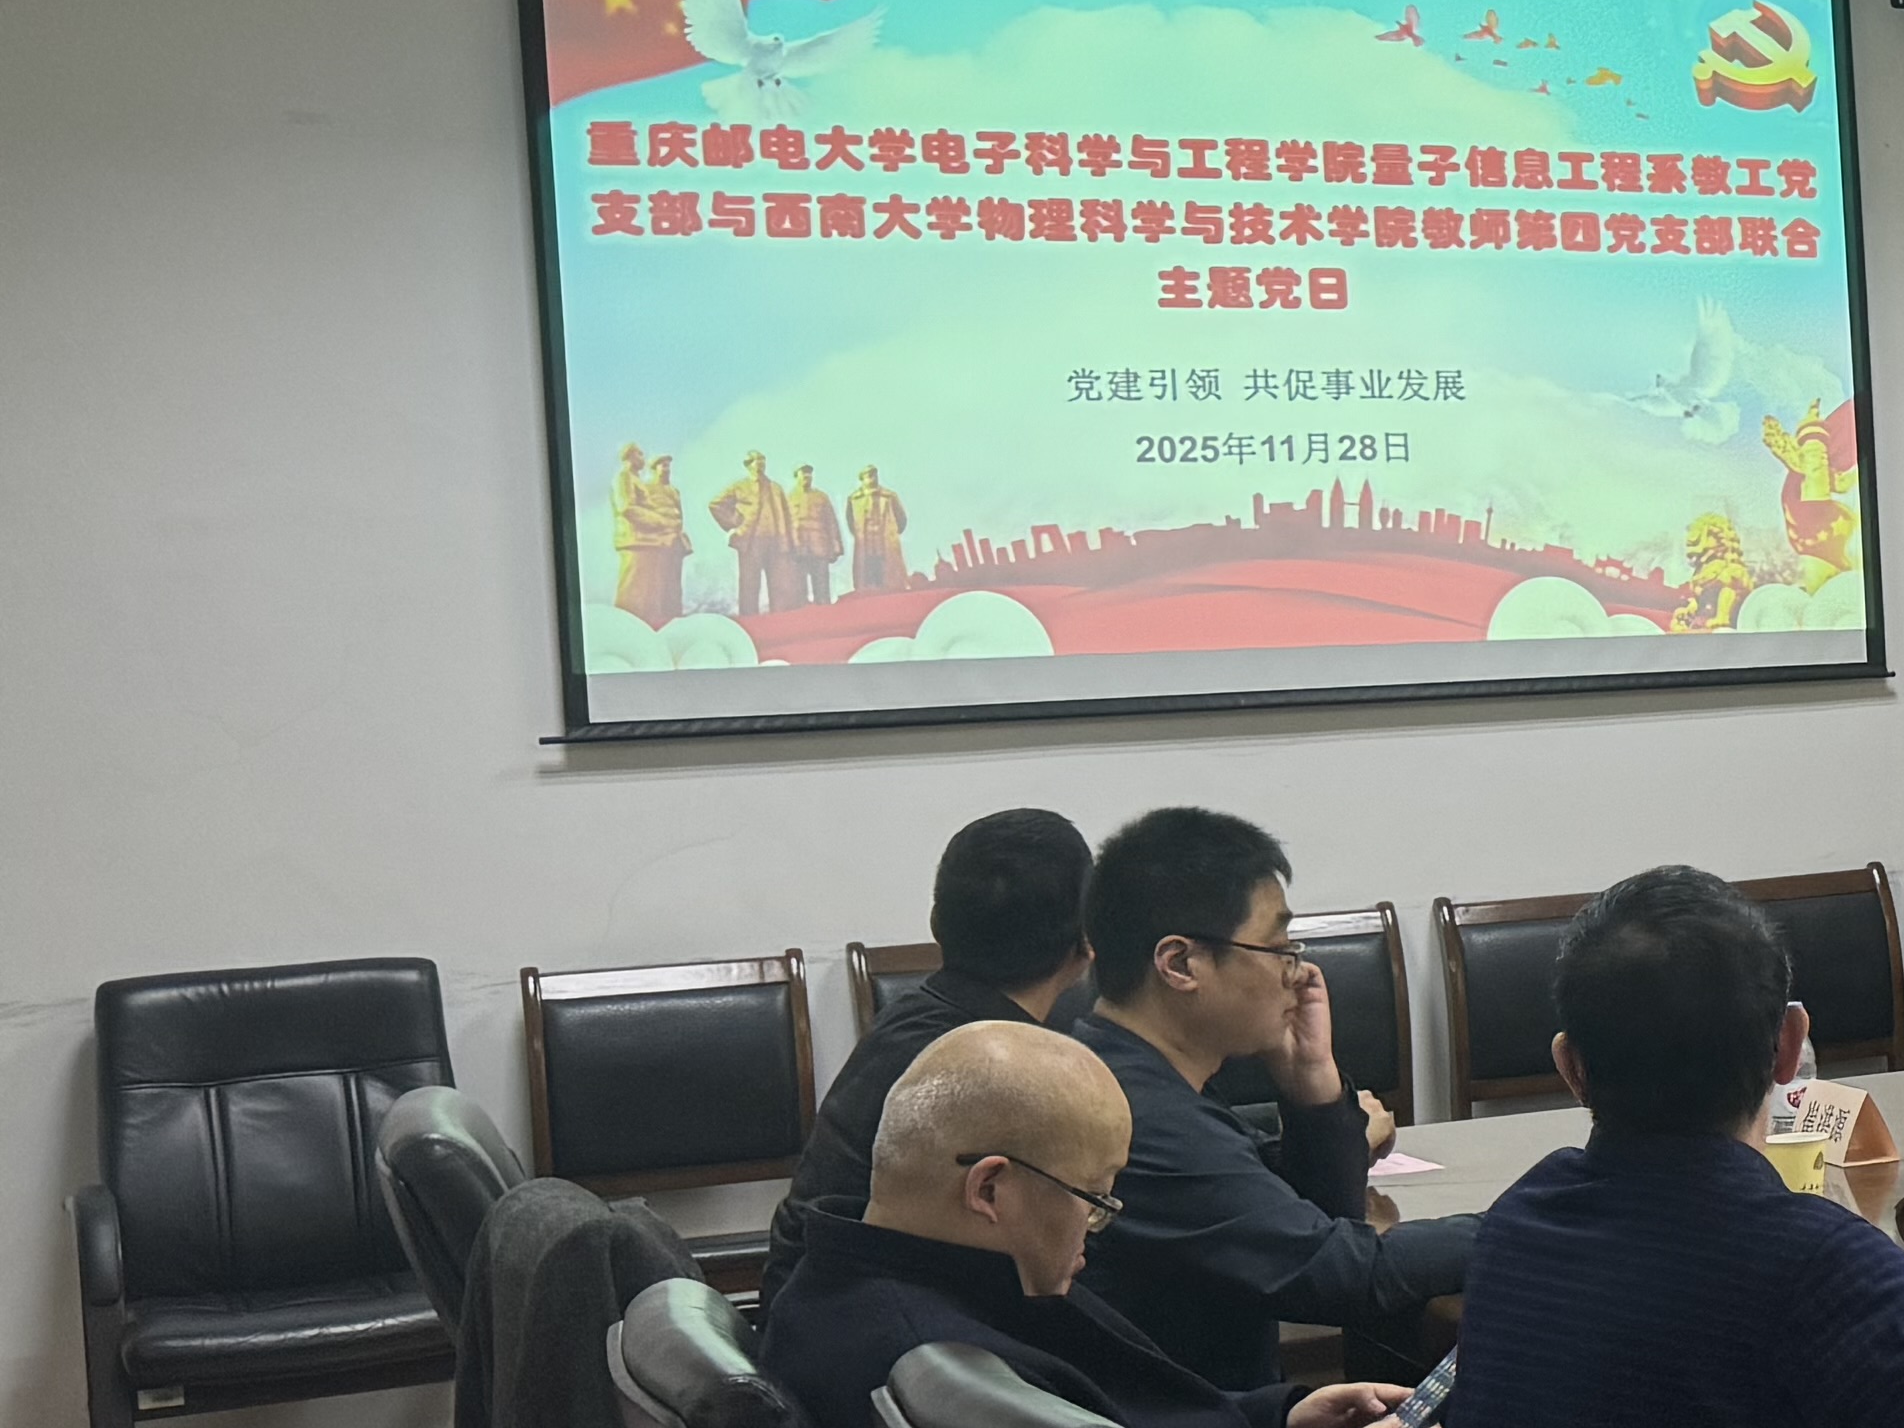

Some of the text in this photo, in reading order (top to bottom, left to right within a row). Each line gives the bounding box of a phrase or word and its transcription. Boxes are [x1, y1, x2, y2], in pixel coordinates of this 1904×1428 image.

[586, 120, 1819, 200] 重庆邮电大学电子科学与工程学院量子信息工程系教工党
[591, 189, 1822, 260] 支部与西南大学物理科学与技术学院教师第四党支部联合
[1157, 266, 1349, 311] 主题党日
[1066, 367, 1466, 403] 党建引领 共促事业发展
[1135, 431, 1411, 465] 2025年11月28日
